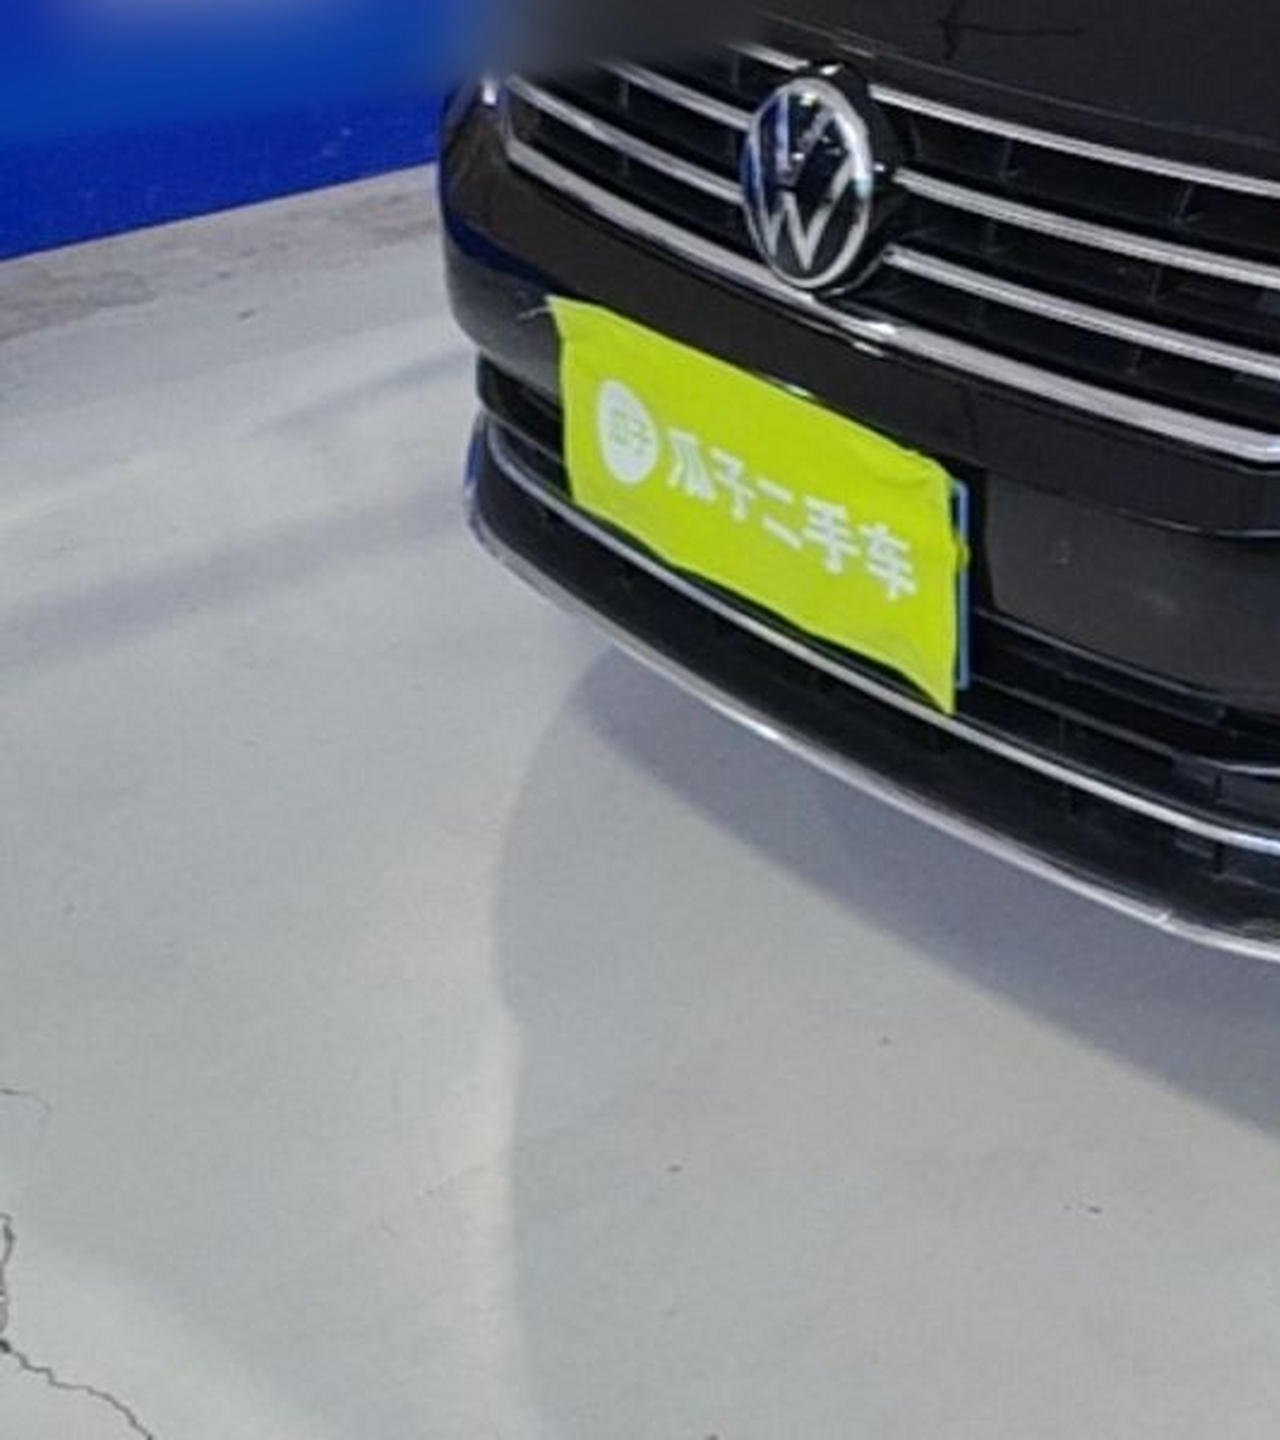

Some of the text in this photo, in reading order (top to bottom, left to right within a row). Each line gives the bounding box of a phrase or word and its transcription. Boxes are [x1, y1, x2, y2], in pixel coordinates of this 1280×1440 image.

[665, 426, 918, 603] 瓜子二手车
